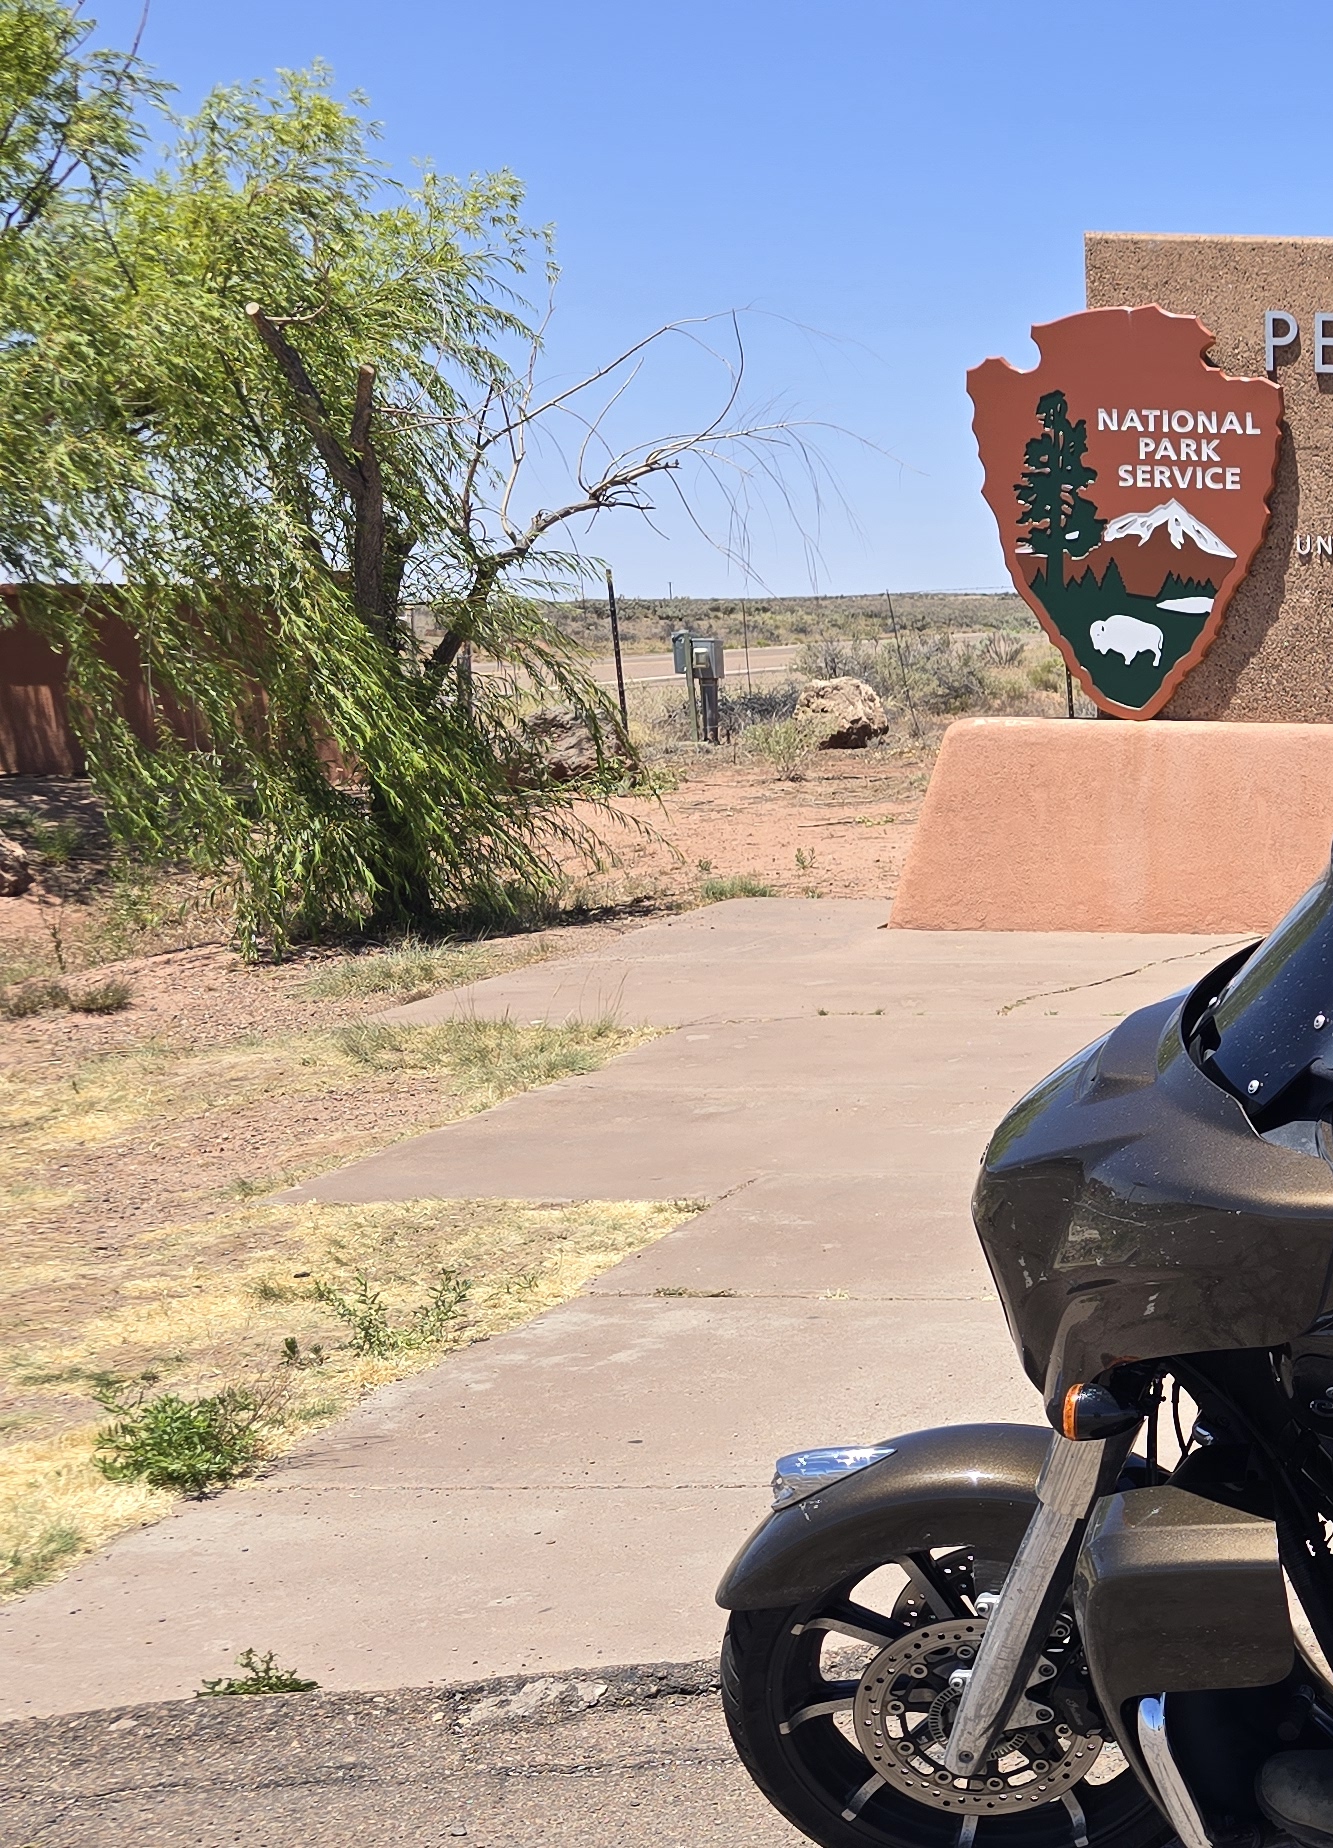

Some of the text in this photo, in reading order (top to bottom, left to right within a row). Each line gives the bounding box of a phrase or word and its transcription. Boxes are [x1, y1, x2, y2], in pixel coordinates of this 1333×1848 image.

[1097, 408, 1261, 435] NATIONAL
[1139, 437, 1221, 462] PARK
[1118, 465, 1241, 490] SERVICE
